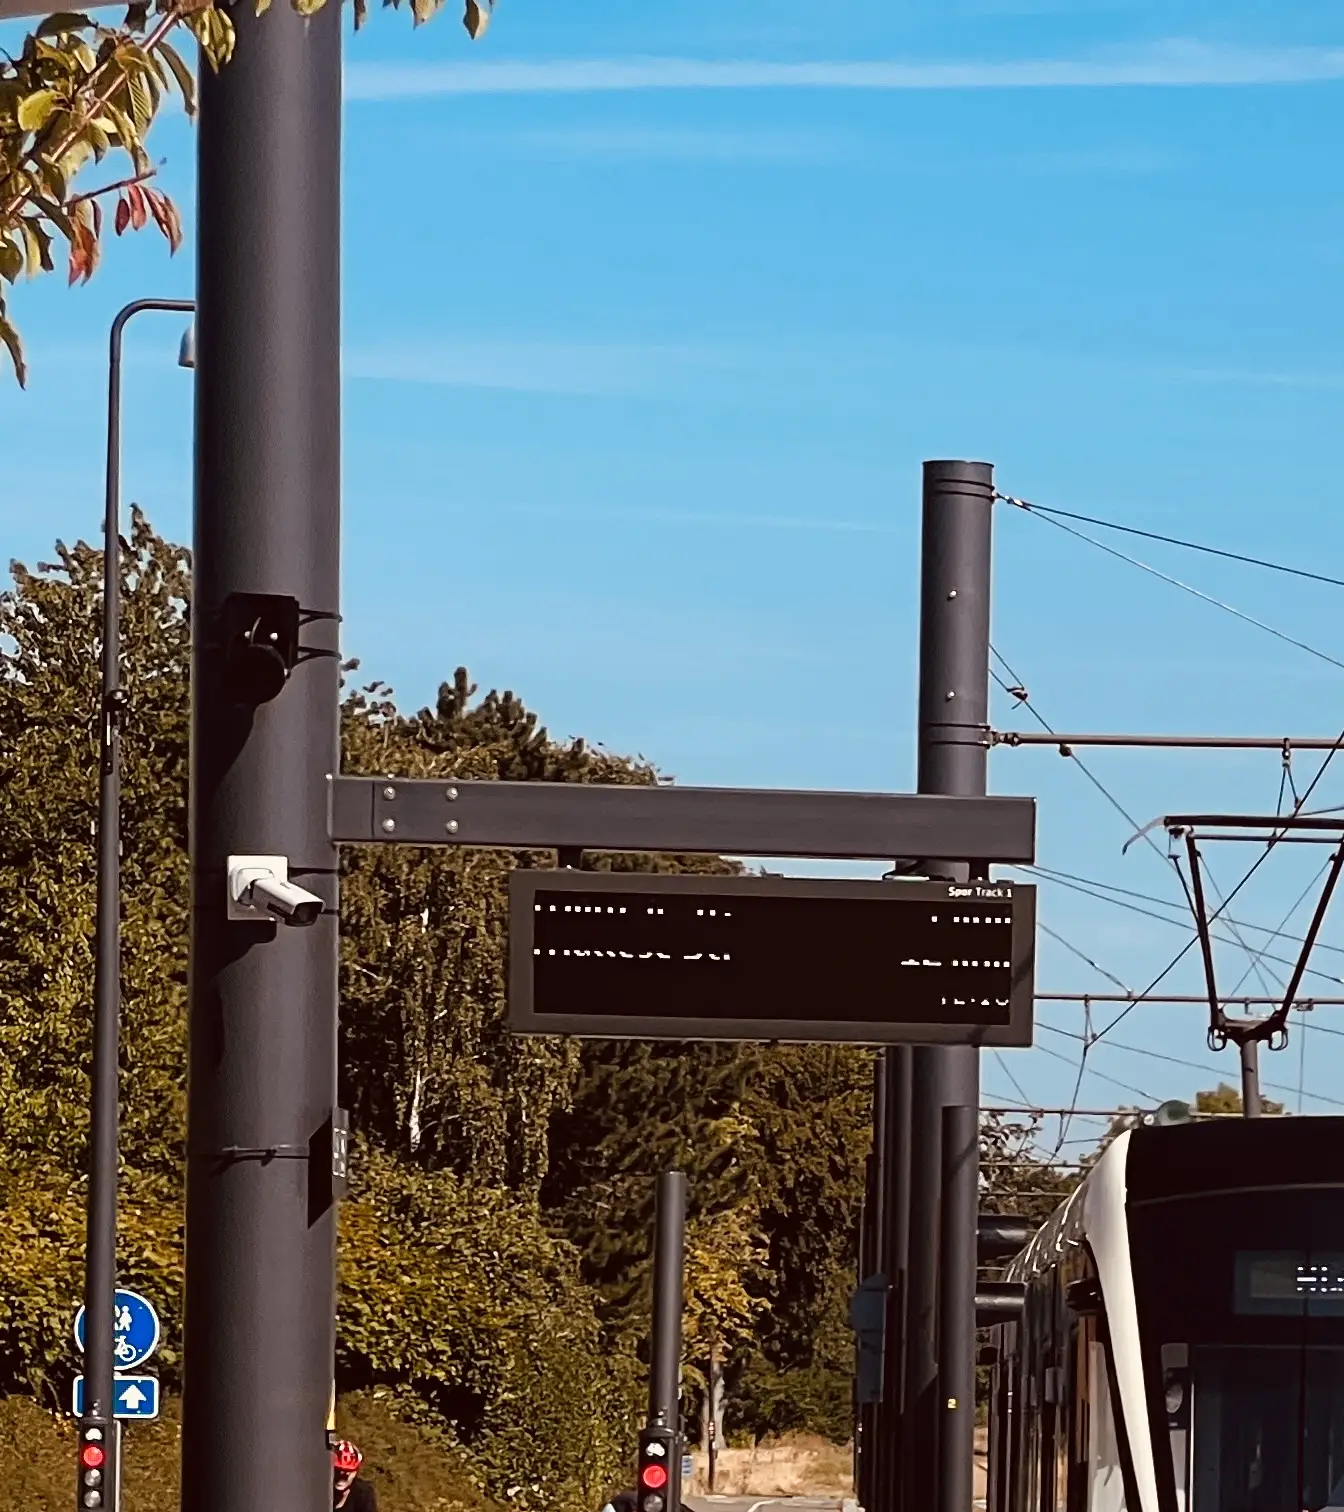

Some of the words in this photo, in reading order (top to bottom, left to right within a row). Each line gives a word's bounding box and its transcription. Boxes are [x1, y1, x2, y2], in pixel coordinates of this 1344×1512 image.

[948, 886, 973, 898] Spor
[975, 886, 1003, 898] Track
[1006, 888, 1012, 898] 1
